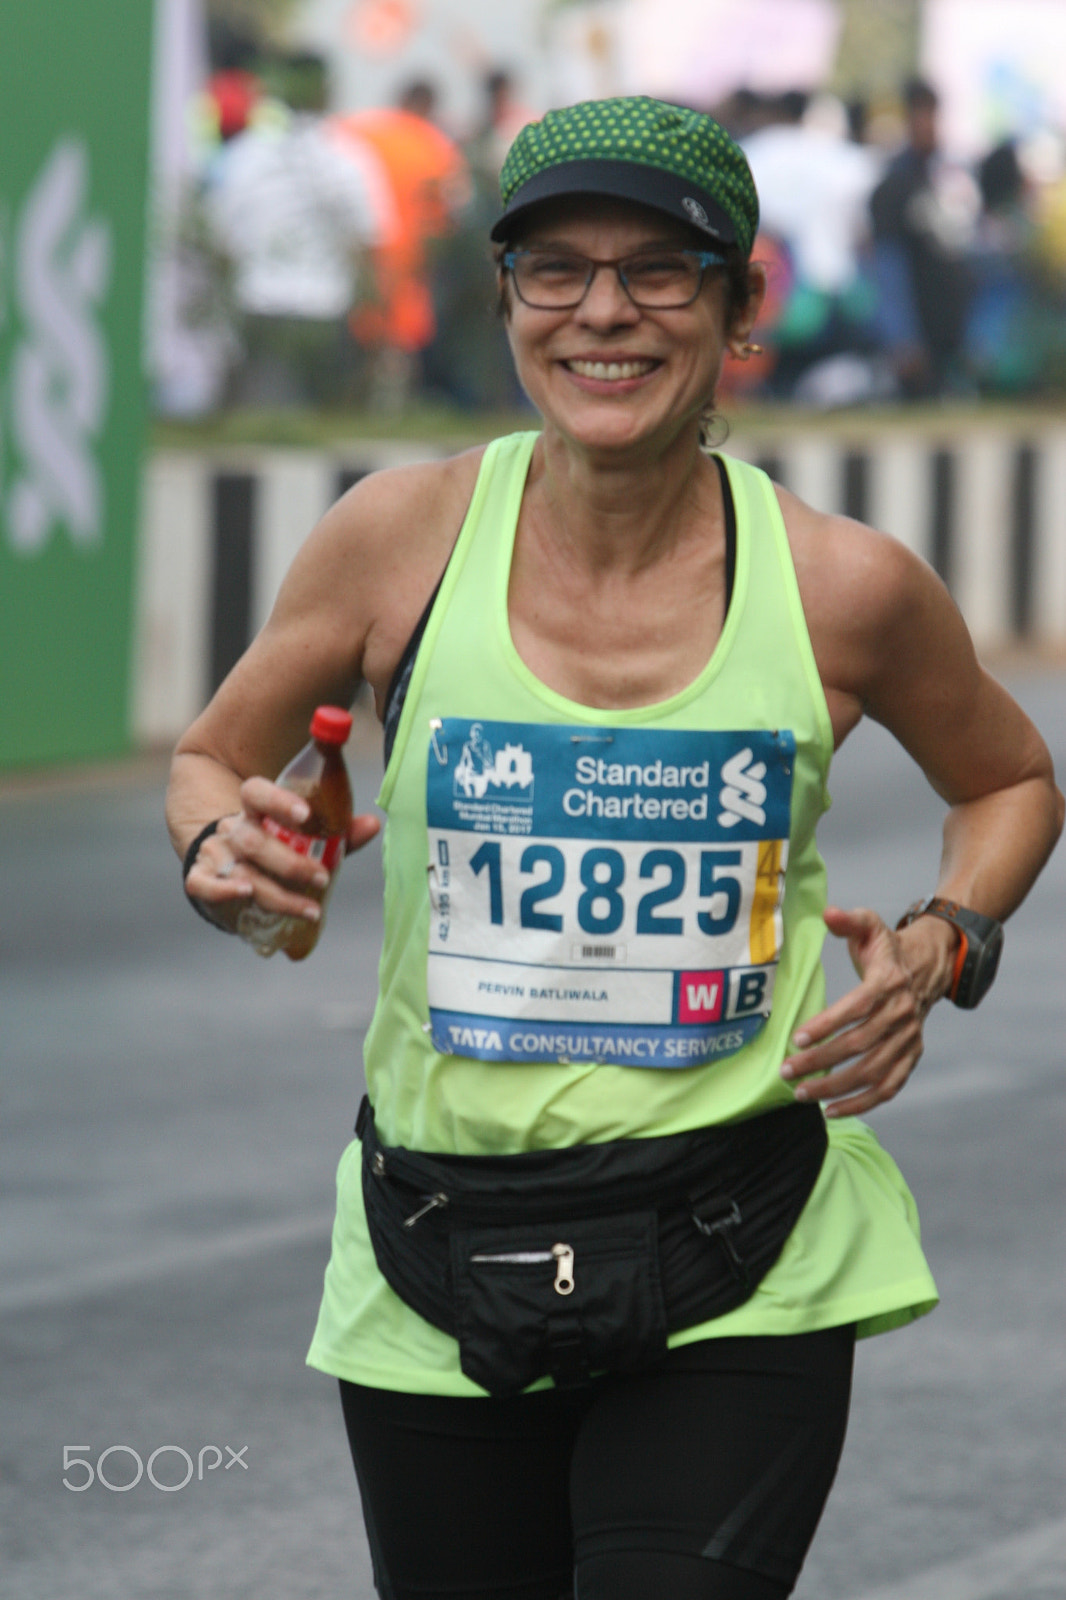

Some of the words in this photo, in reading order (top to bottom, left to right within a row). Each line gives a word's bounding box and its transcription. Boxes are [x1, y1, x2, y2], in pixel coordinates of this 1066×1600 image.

[575, 756, 710, 788] Standard
[562, 788, 708, 820] Chartered
[469, 841, 742, 936] 12825
[478, 981, 525, 998] PERVIN
[530, 988, 608, 1001] BATLIWALA
[686, 984, 718, 1011] W
[736, 973, 767, 1013] B
[448, 1025, 503, 1051] TATA
[509, 1033, 660, 1058] CONSULTANCY
[664, 1030, 743, 1058] SERVICES
